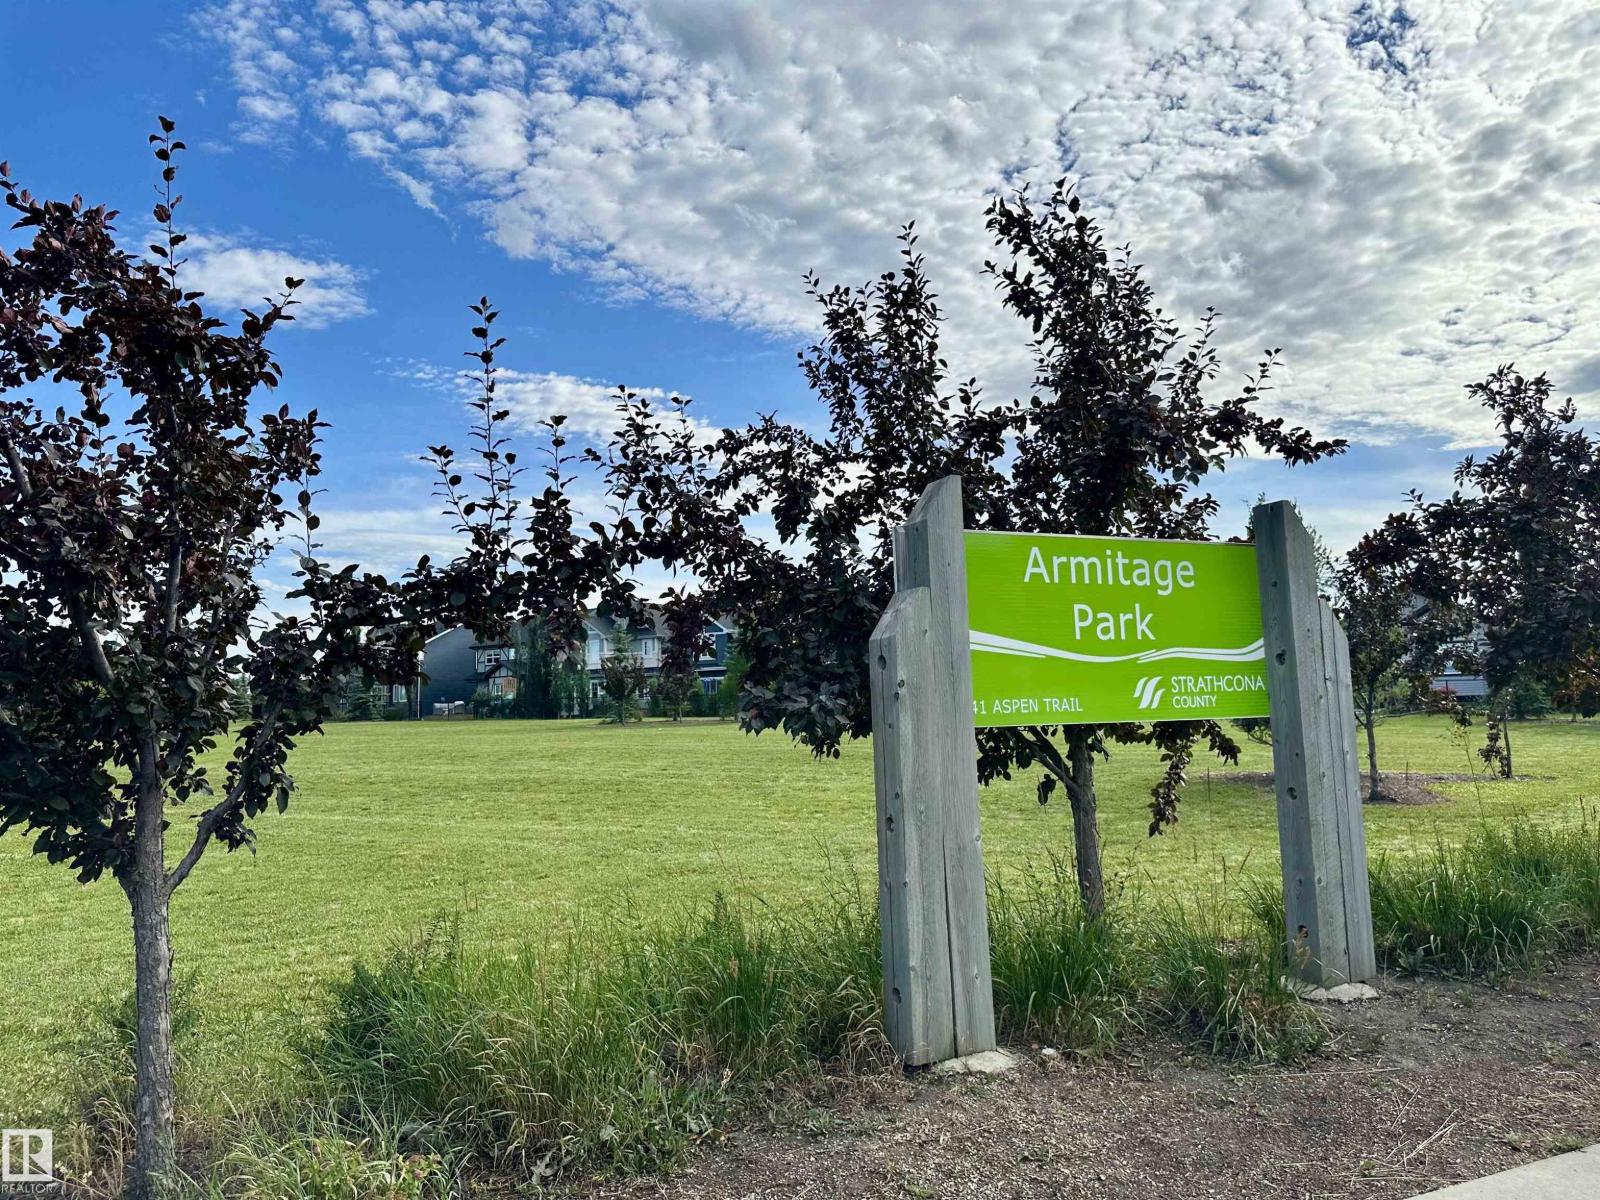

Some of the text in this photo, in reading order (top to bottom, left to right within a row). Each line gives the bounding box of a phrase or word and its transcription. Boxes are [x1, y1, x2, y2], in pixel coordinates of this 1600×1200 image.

[1023, 546, 1196, 596] Armitage
[1073, 603, 1156, 641] Park
[1171, 675, 1266, 693] STRATHCONA
[992, 698, 1039, 714] ASPEN
[1043, 697, 1083, 713] TRAIL
[1172, 695, 1217, 709] COUNTY
